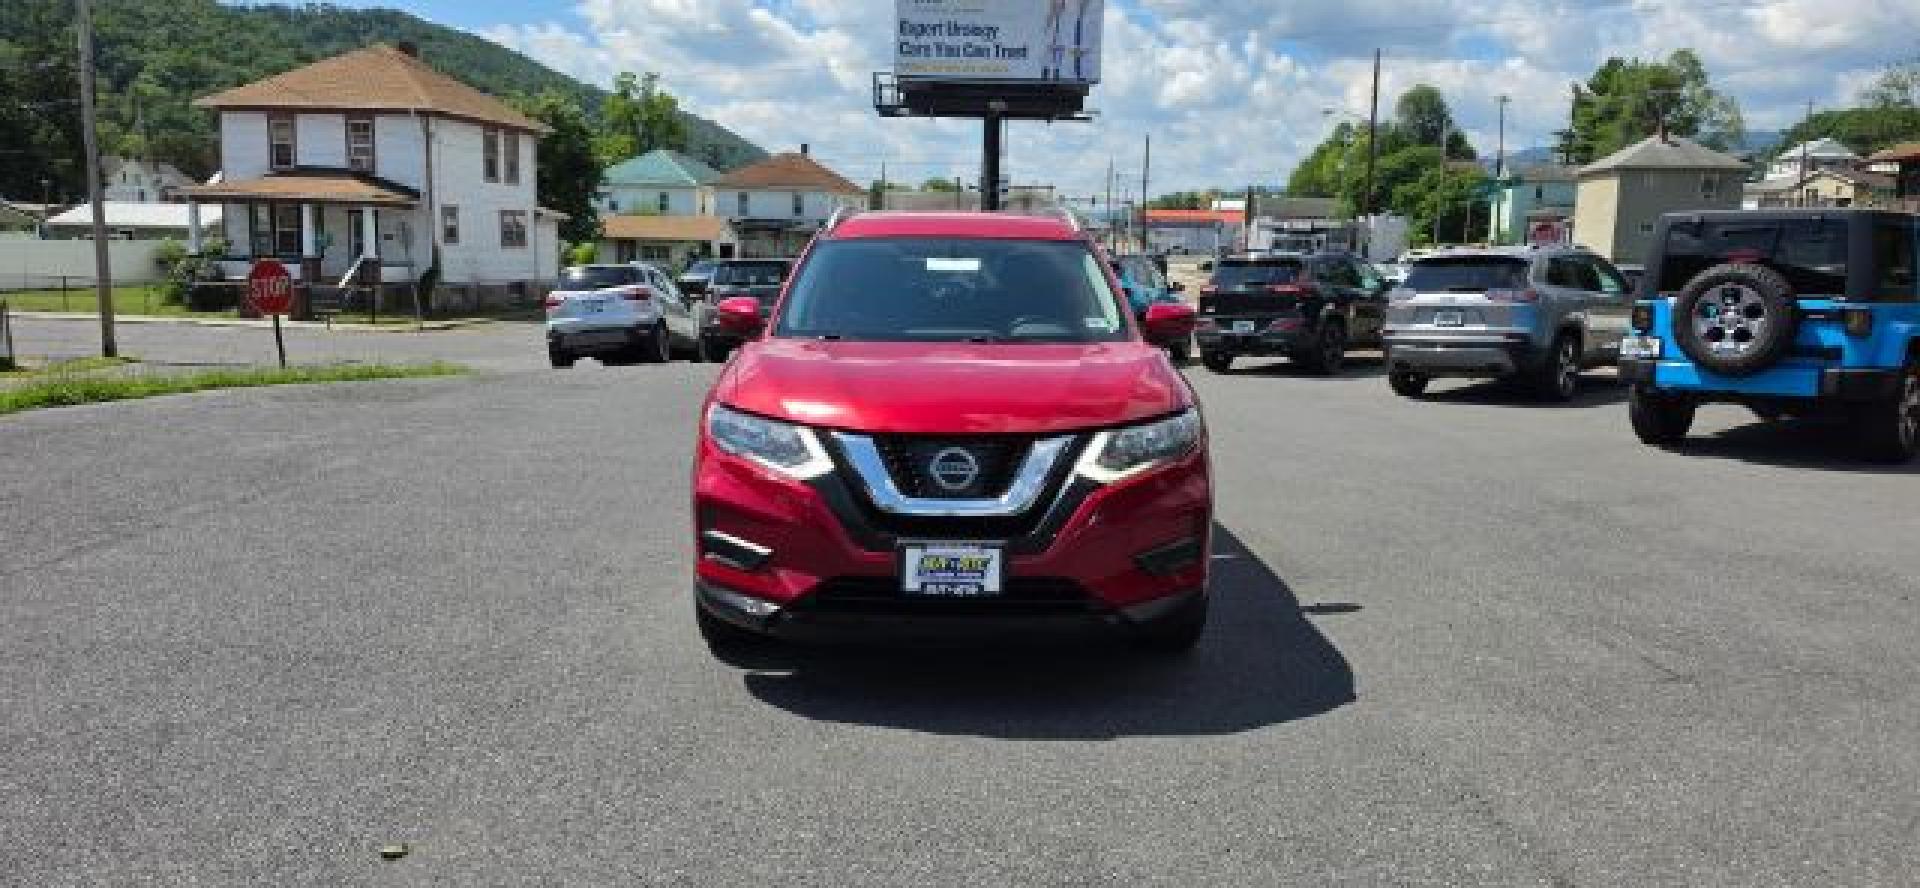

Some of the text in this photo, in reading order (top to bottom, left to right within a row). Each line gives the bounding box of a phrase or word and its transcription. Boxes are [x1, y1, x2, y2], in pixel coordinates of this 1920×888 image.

[899, 19, 999, 40] Expert Urology
[899, 41, 931, 58] Care
[933, 42, 961, 58] You
[962, 42, 991, 58] Can
[251, 275, 289, 298] STOP
